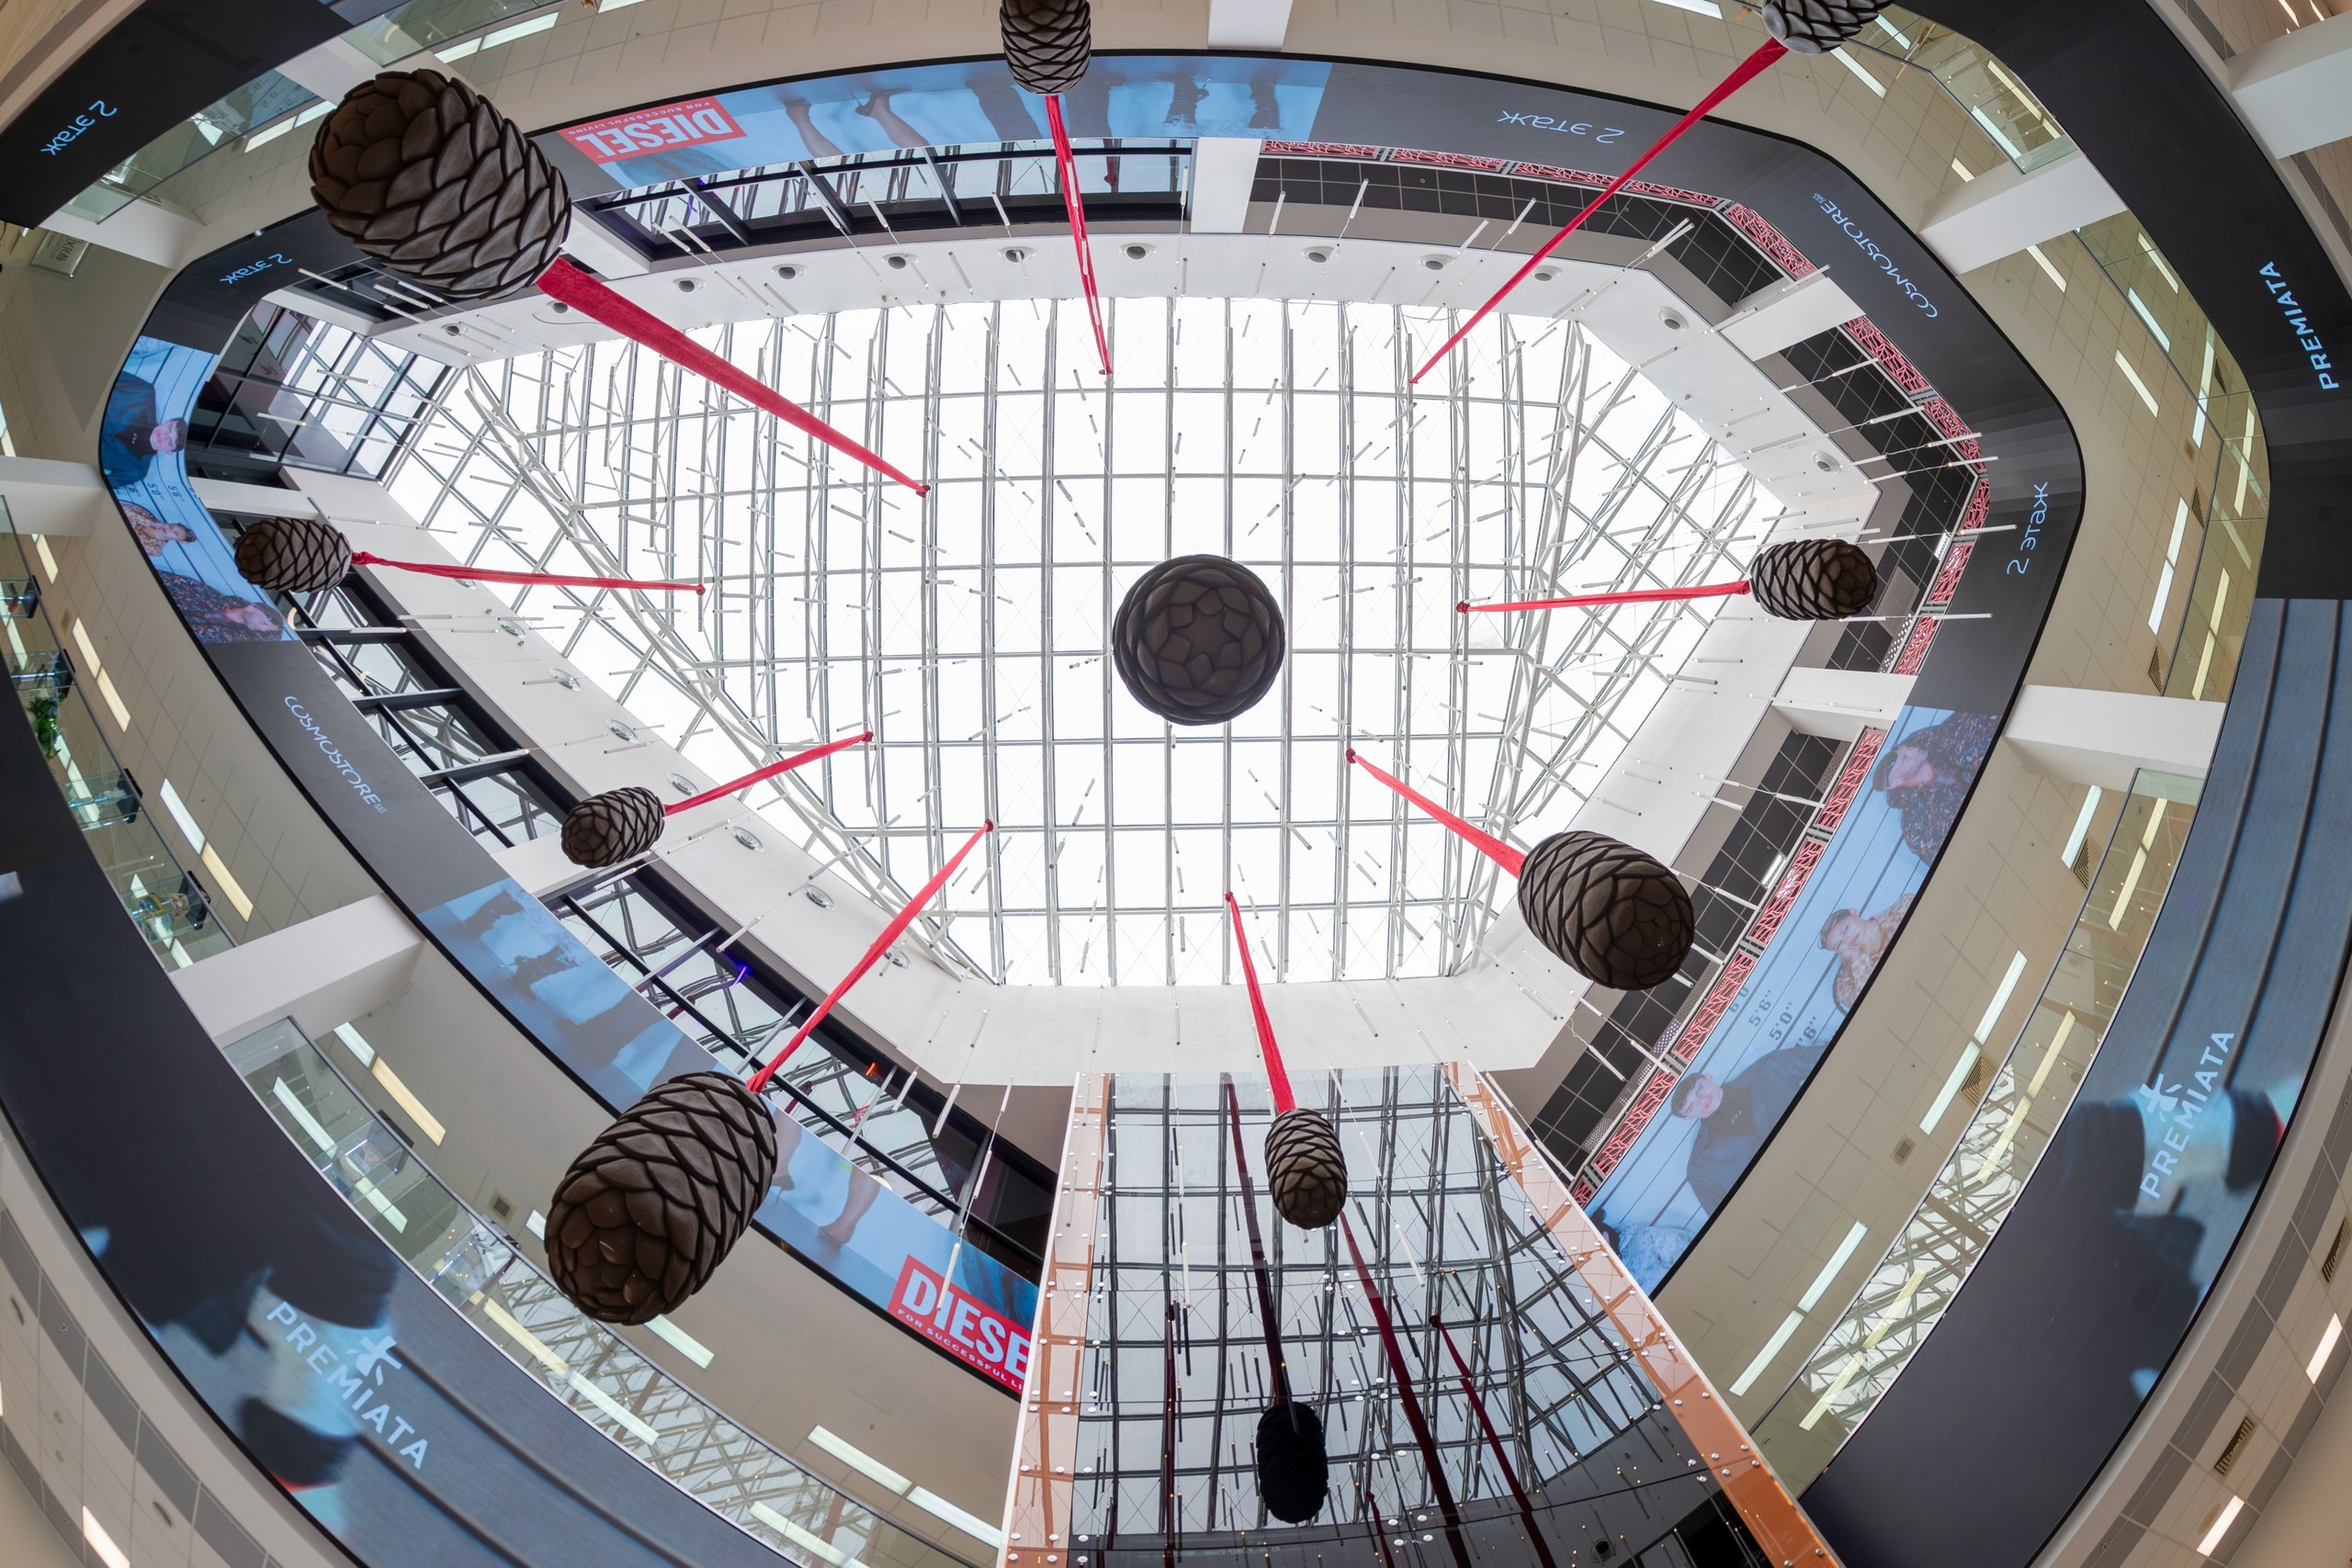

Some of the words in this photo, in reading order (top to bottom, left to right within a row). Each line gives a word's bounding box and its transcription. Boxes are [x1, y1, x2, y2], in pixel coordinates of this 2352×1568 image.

[88, 100, 118, 117] 2
[607, 107, 683, 126] SUCCESSFUL
[685, 101, 710, 110] FOR
[1497, 109, 1593, 135] этаж
[40, 114, 96, 155] этаж
[568, 123, 606, 135] LIVING
[575, 107, 734, 157] DIESEL
[1596, 127, 1625, 143] 2
[220, 260, 273, 285] этаж
[268, 253, 293, 265] 2
[1819, 199, 1939, 319] COSMOSTORE
[2259, 261, 2340, 389] PREMIATA
[2007, 558, 2030, 574] 2
[2020, 481, 2049, 551] этаж
[284, 695, 381, 806] COSMOSTORE
[2140, 1032, 2235, 1200] PREMIATA
[897, 1308, 923, 1328] FOR
[926, 1327, 1007, 1382] SUCCESSFUL
[900, 1268, 1031, 1382] DIESE
[266, 1301, 429, 1470] PREMIATA
